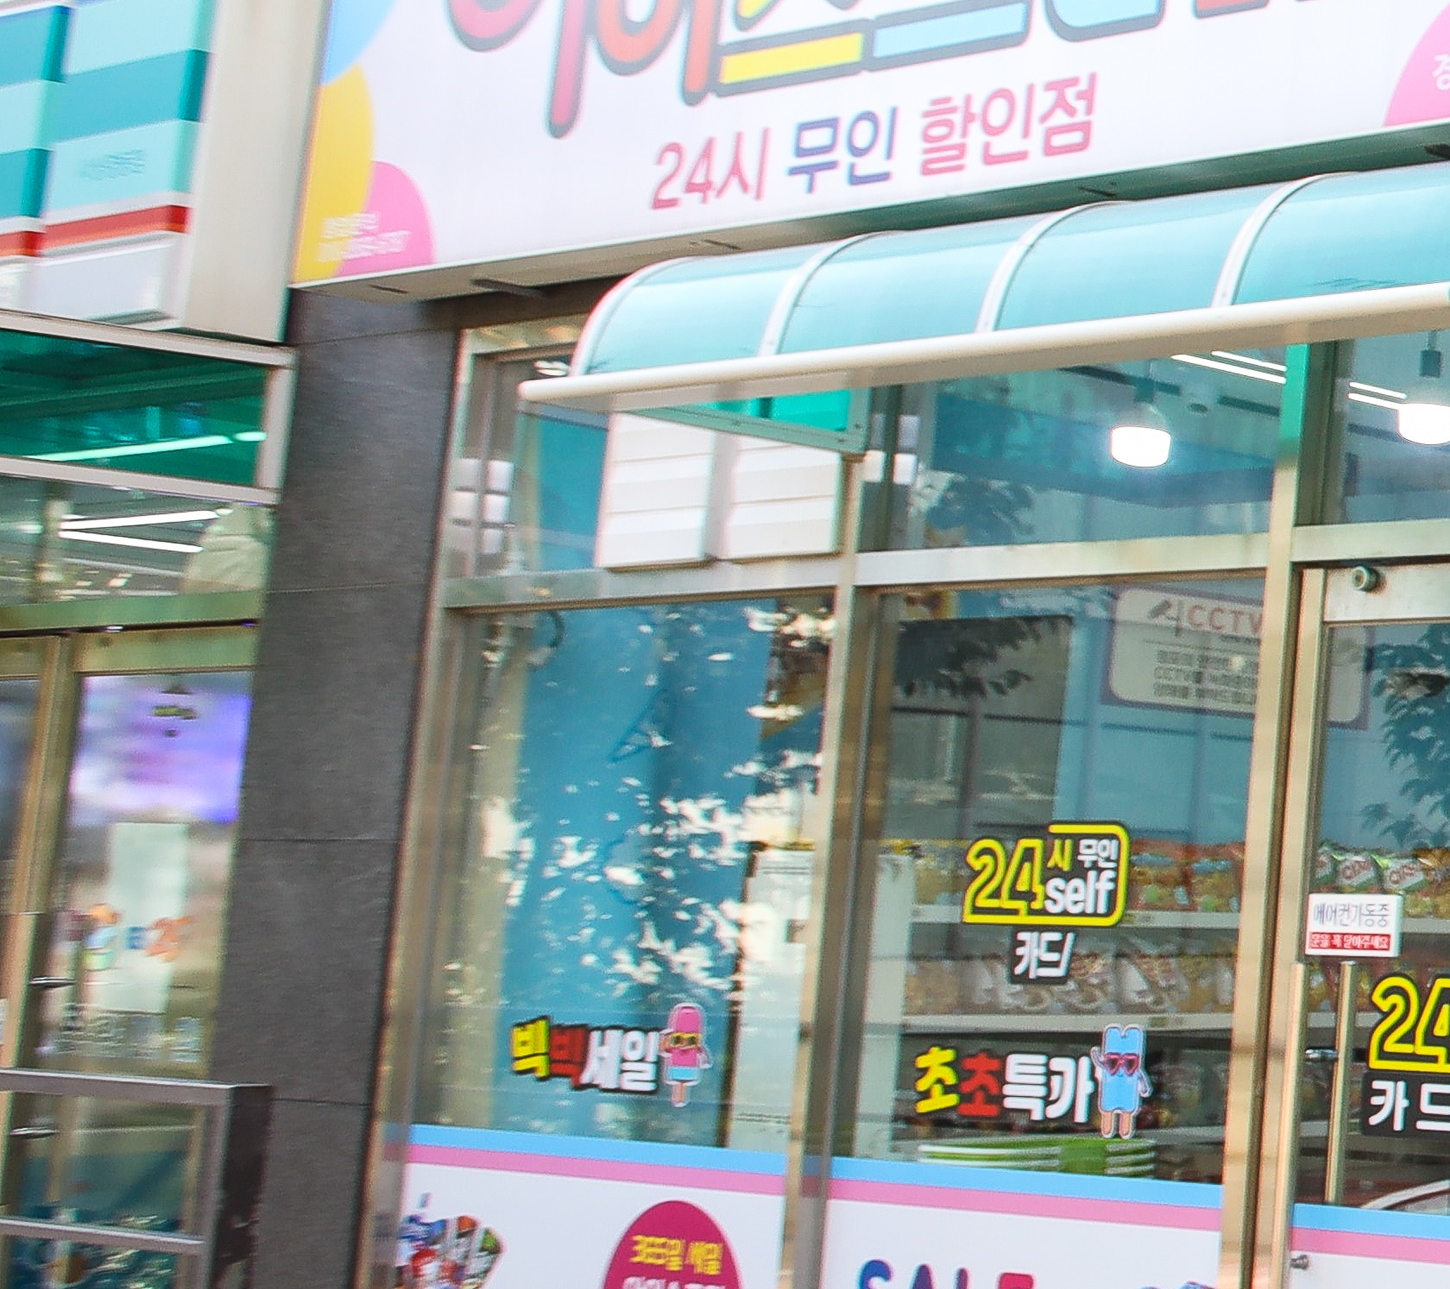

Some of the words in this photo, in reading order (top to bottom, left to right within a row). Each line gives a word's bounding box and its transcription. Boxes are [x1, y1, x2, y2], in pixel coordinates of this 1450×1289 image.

[651, 127, 771, 210] 24시
[788, 106, 897, 194] 무인
[920, 72, 1098, 177] 할인점
[1077, 838, 1119, 868] 무인
[1044, 870, 1118, 914] self
[915, 1046, 1096, 1123] 초초특가
